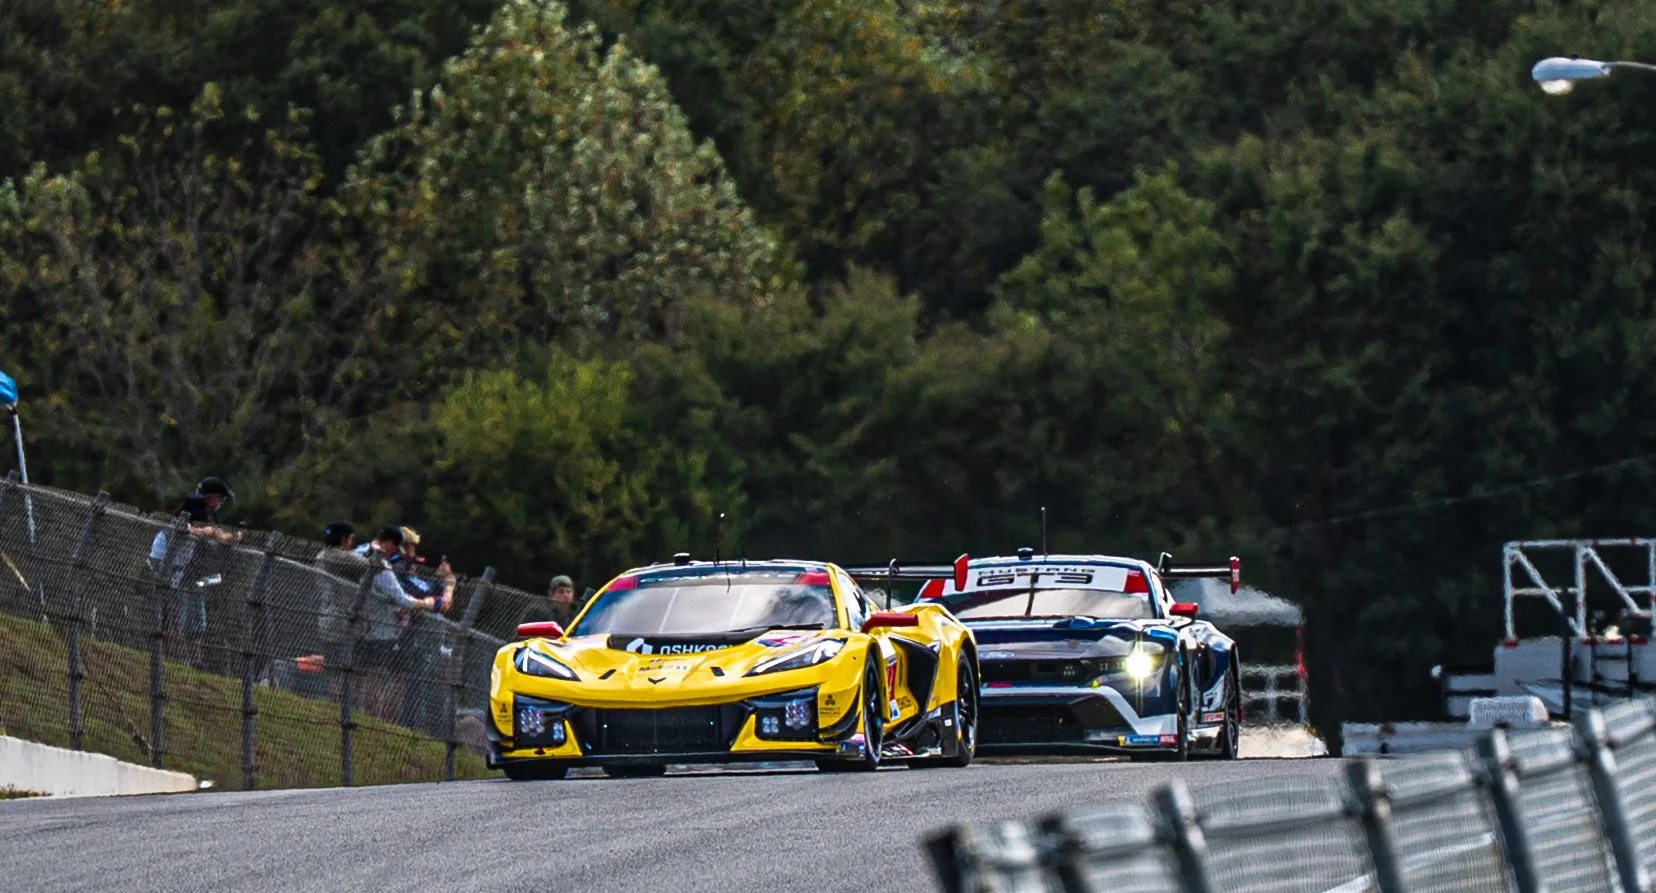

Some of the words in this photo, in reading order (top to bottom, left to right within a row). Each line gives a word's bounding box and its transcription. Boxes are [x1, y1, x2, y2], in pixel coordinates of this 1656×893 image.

[978, 567, 1096, 575] MUSTANG
[976, 572, 1094, 587] GT3
[660, 644, 733, 656] OSHKO
